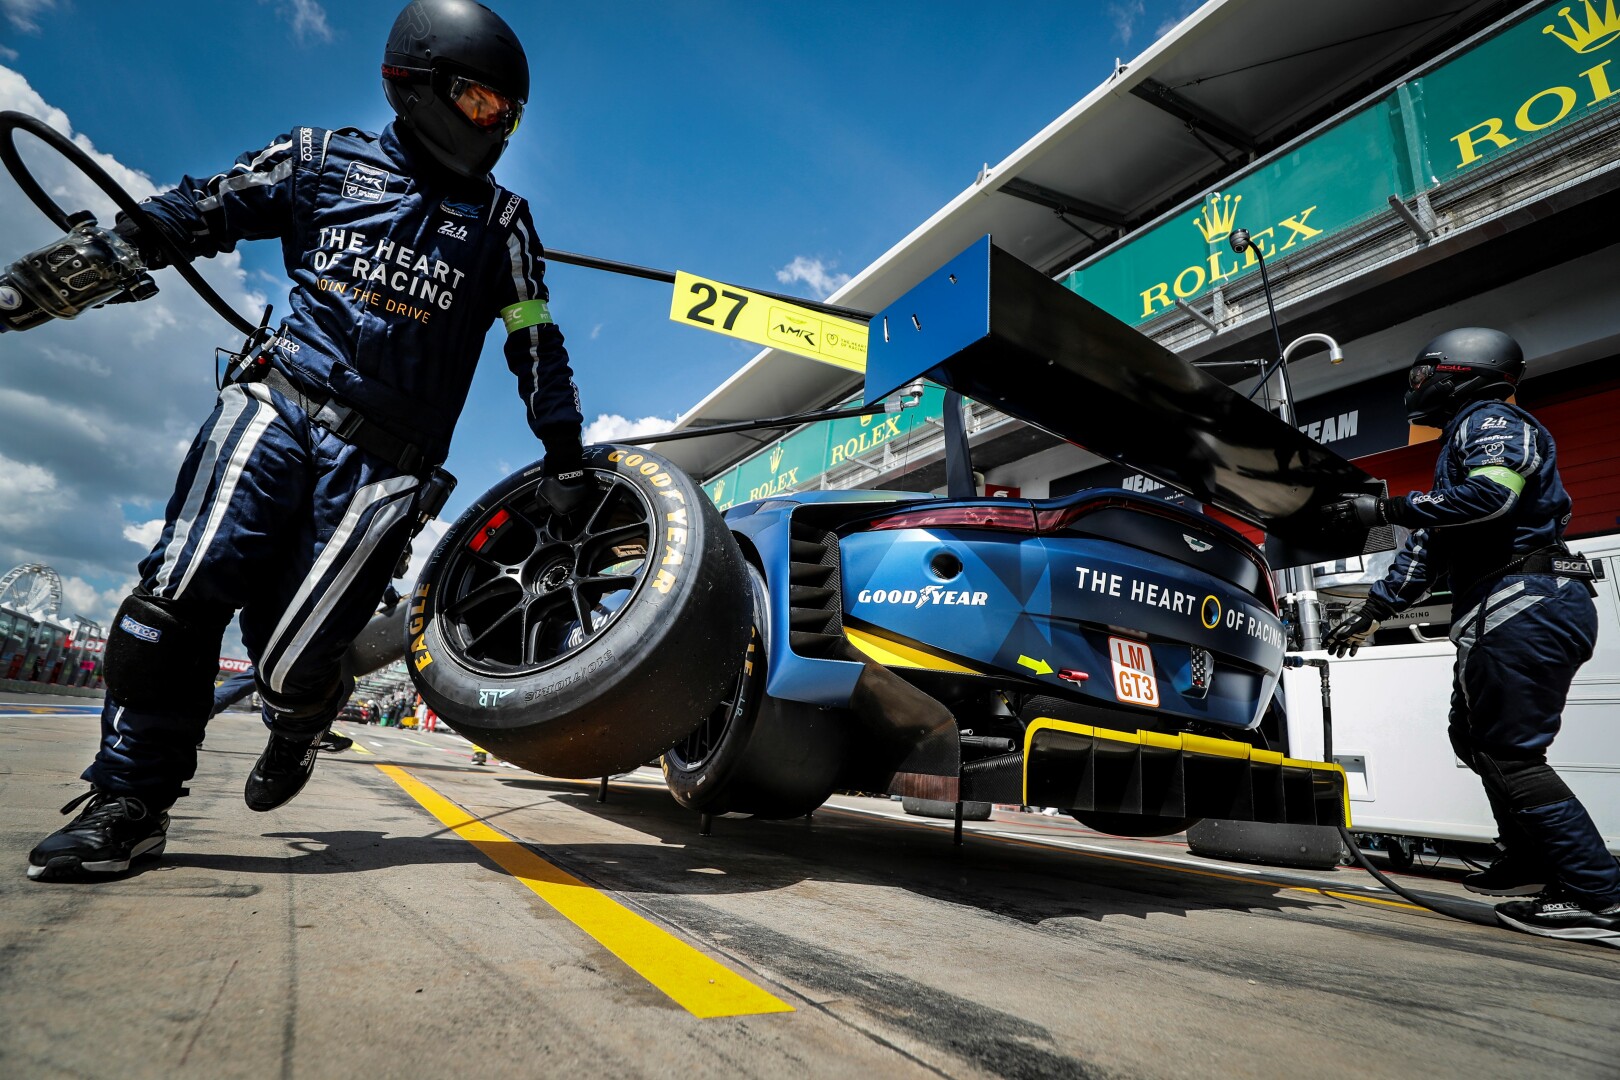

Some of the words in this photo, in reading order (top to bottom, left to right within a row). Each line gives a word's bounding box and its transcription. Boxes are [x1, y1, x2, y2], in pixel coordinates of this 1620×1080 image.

[300, 127, 313, 161] sparco
[499, 194, 521, 228] sparco
[319, 228, 366, 253] THE
[375, 239, 465, 290] HEART
[1139, 205, 1324, 319] ROLEX
[314, 251, 343, 272] OF
[351, 257, 453, 310] RACING
[352, 287, 382, 307] THE
[385, 298, 431, 325] DRIVE
[686, 282, 749, 331] 27
[772, 323, 816, 347] AMR
[830, 415, 901, 466] ROLEX
[750, 467, 799, 501] ROLEX
[607, 450, 688, 594] GOODYEAR
[857, 587, 988, 607] GOODYEAR
[1076, 566, 1123, 597] THE
[1131, 579, 1196, 616] HEART
[1226, 609, 1245, 632] OF
[1247, 616, 1282, 649] RACING
[121, 619, 159, 638] sparco
[409, 583, 433, 672] EAGLE
[1399, 611, 1430, 620] RACING
[1117, 642, 1146, 671] LM
[1119, 670, 1154, 701] GT3
